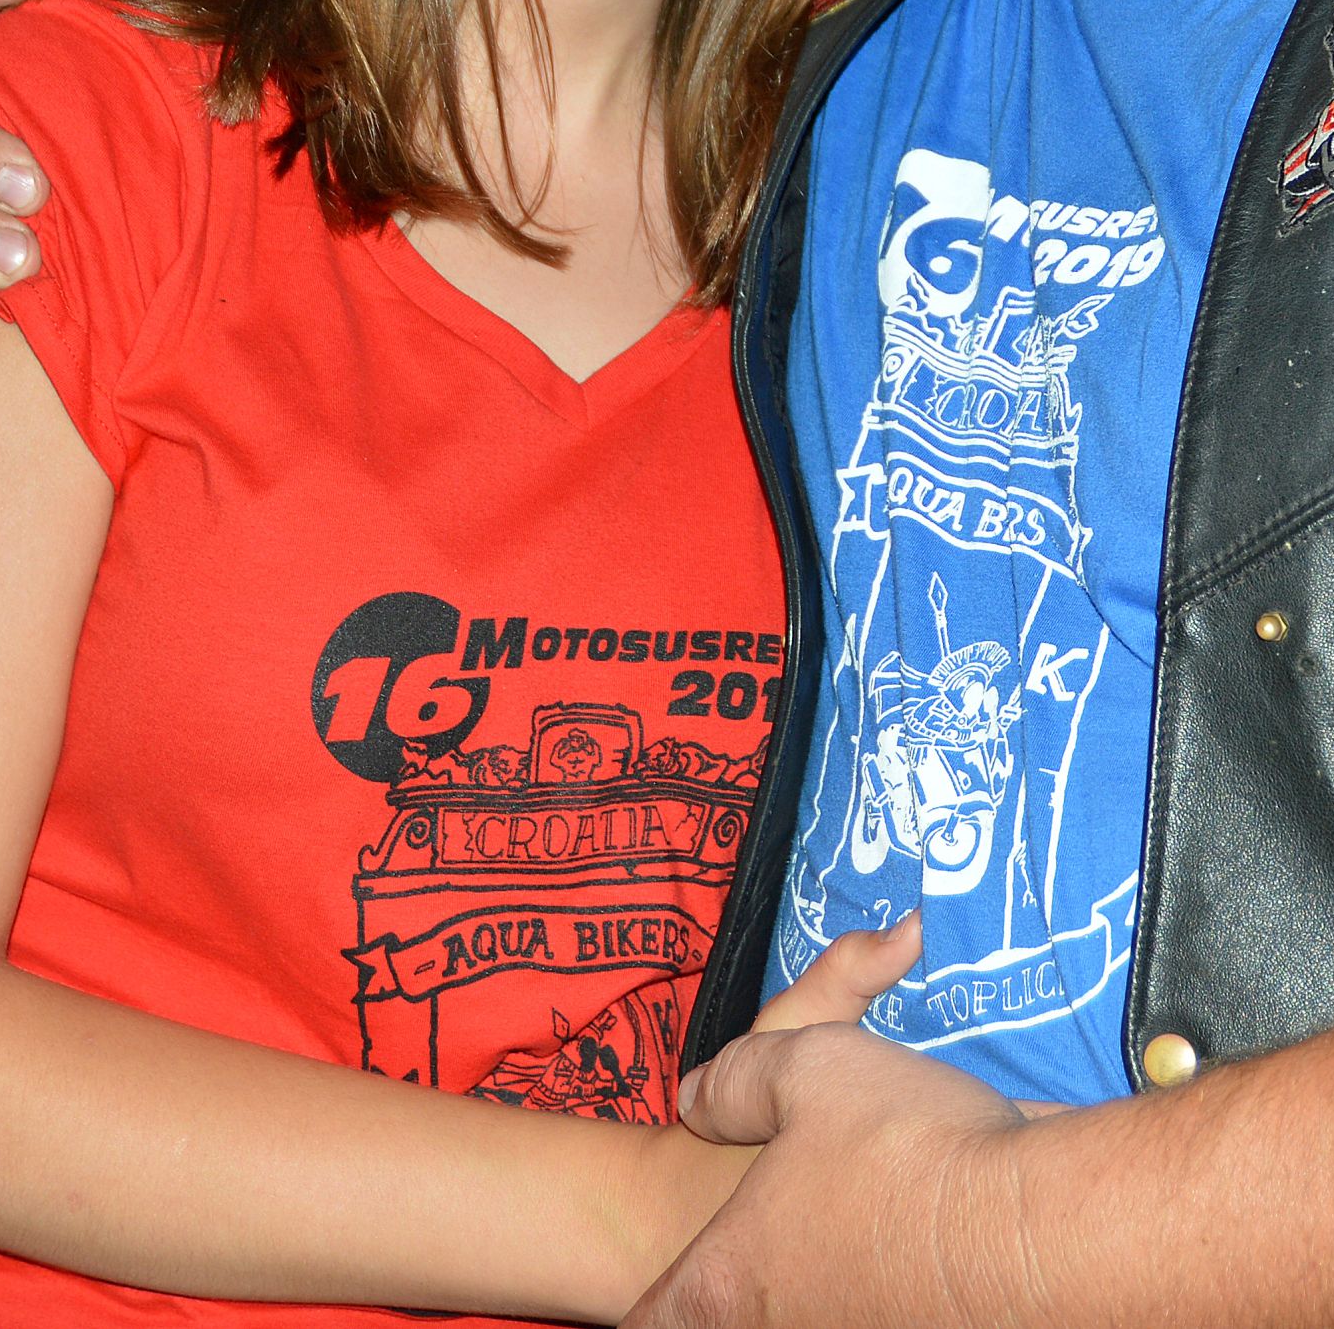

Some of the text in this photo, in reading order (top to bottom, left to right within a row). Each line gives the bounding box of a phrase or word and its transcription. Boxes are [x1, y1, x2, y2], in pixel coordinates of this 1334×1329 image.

[1033, 234, 1167, 289] 2019
[887, 466, 966, 533] QUA
[460, 617, 782, 670] MOTOSUSRE
[1025, 642, 1089, 701] K
[667, 670, 782, 723] 201
[443, 918, 691, 977] AQUA BIKERS
[926, 960, 1066, 1029] TOPLIC
